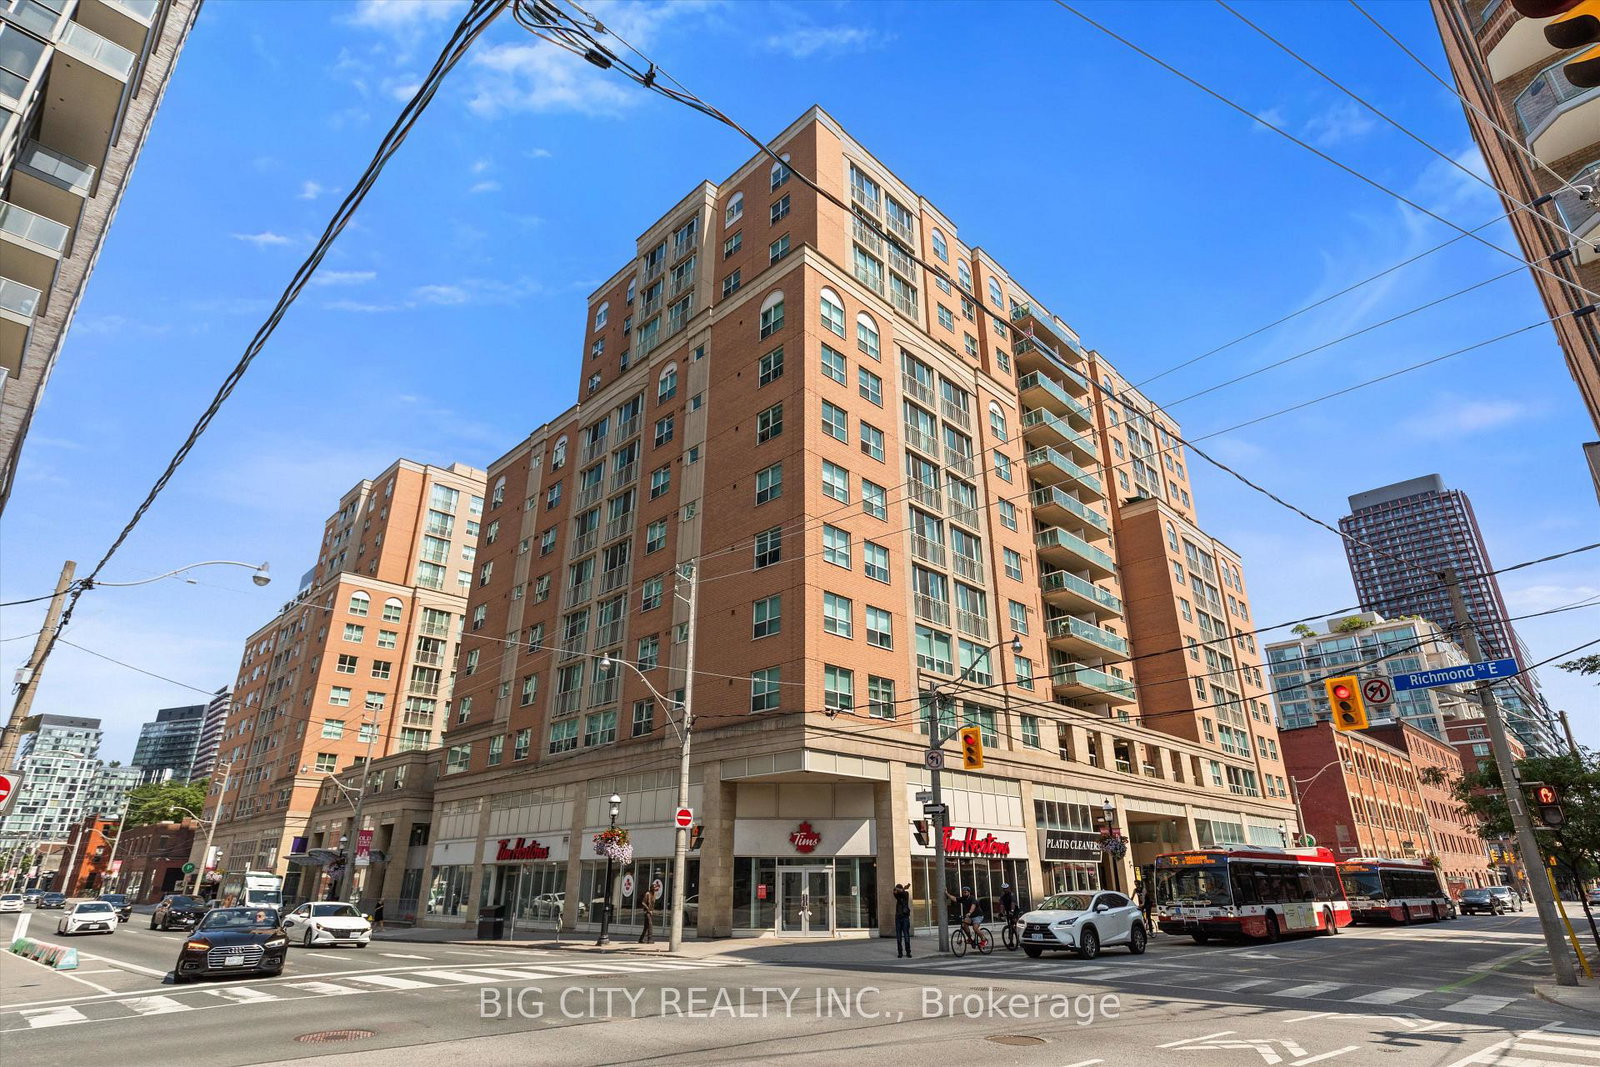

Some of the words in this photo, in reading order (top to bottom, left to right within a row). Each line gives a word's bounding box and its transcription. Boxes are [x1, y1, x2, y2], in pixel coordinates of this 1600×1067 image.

[1409, 666, 1475, 686] Richmond
[1477, 664, 1485, 672] St
[1488, 662, 1498, 674] E
[793, 832, 818, 846] Tims
[942, 826, 964, 852] Tim
[964, 827, 1010, 854] Hortons
[1046, 838, 1070, 849] PLATIS
[1070, 840, 1102, 850] CLEANERS
[496, 839, 513, 860] Tim
[512, 837, 550, 860] Hortons
[1169, 856, 1179, 865] 75
